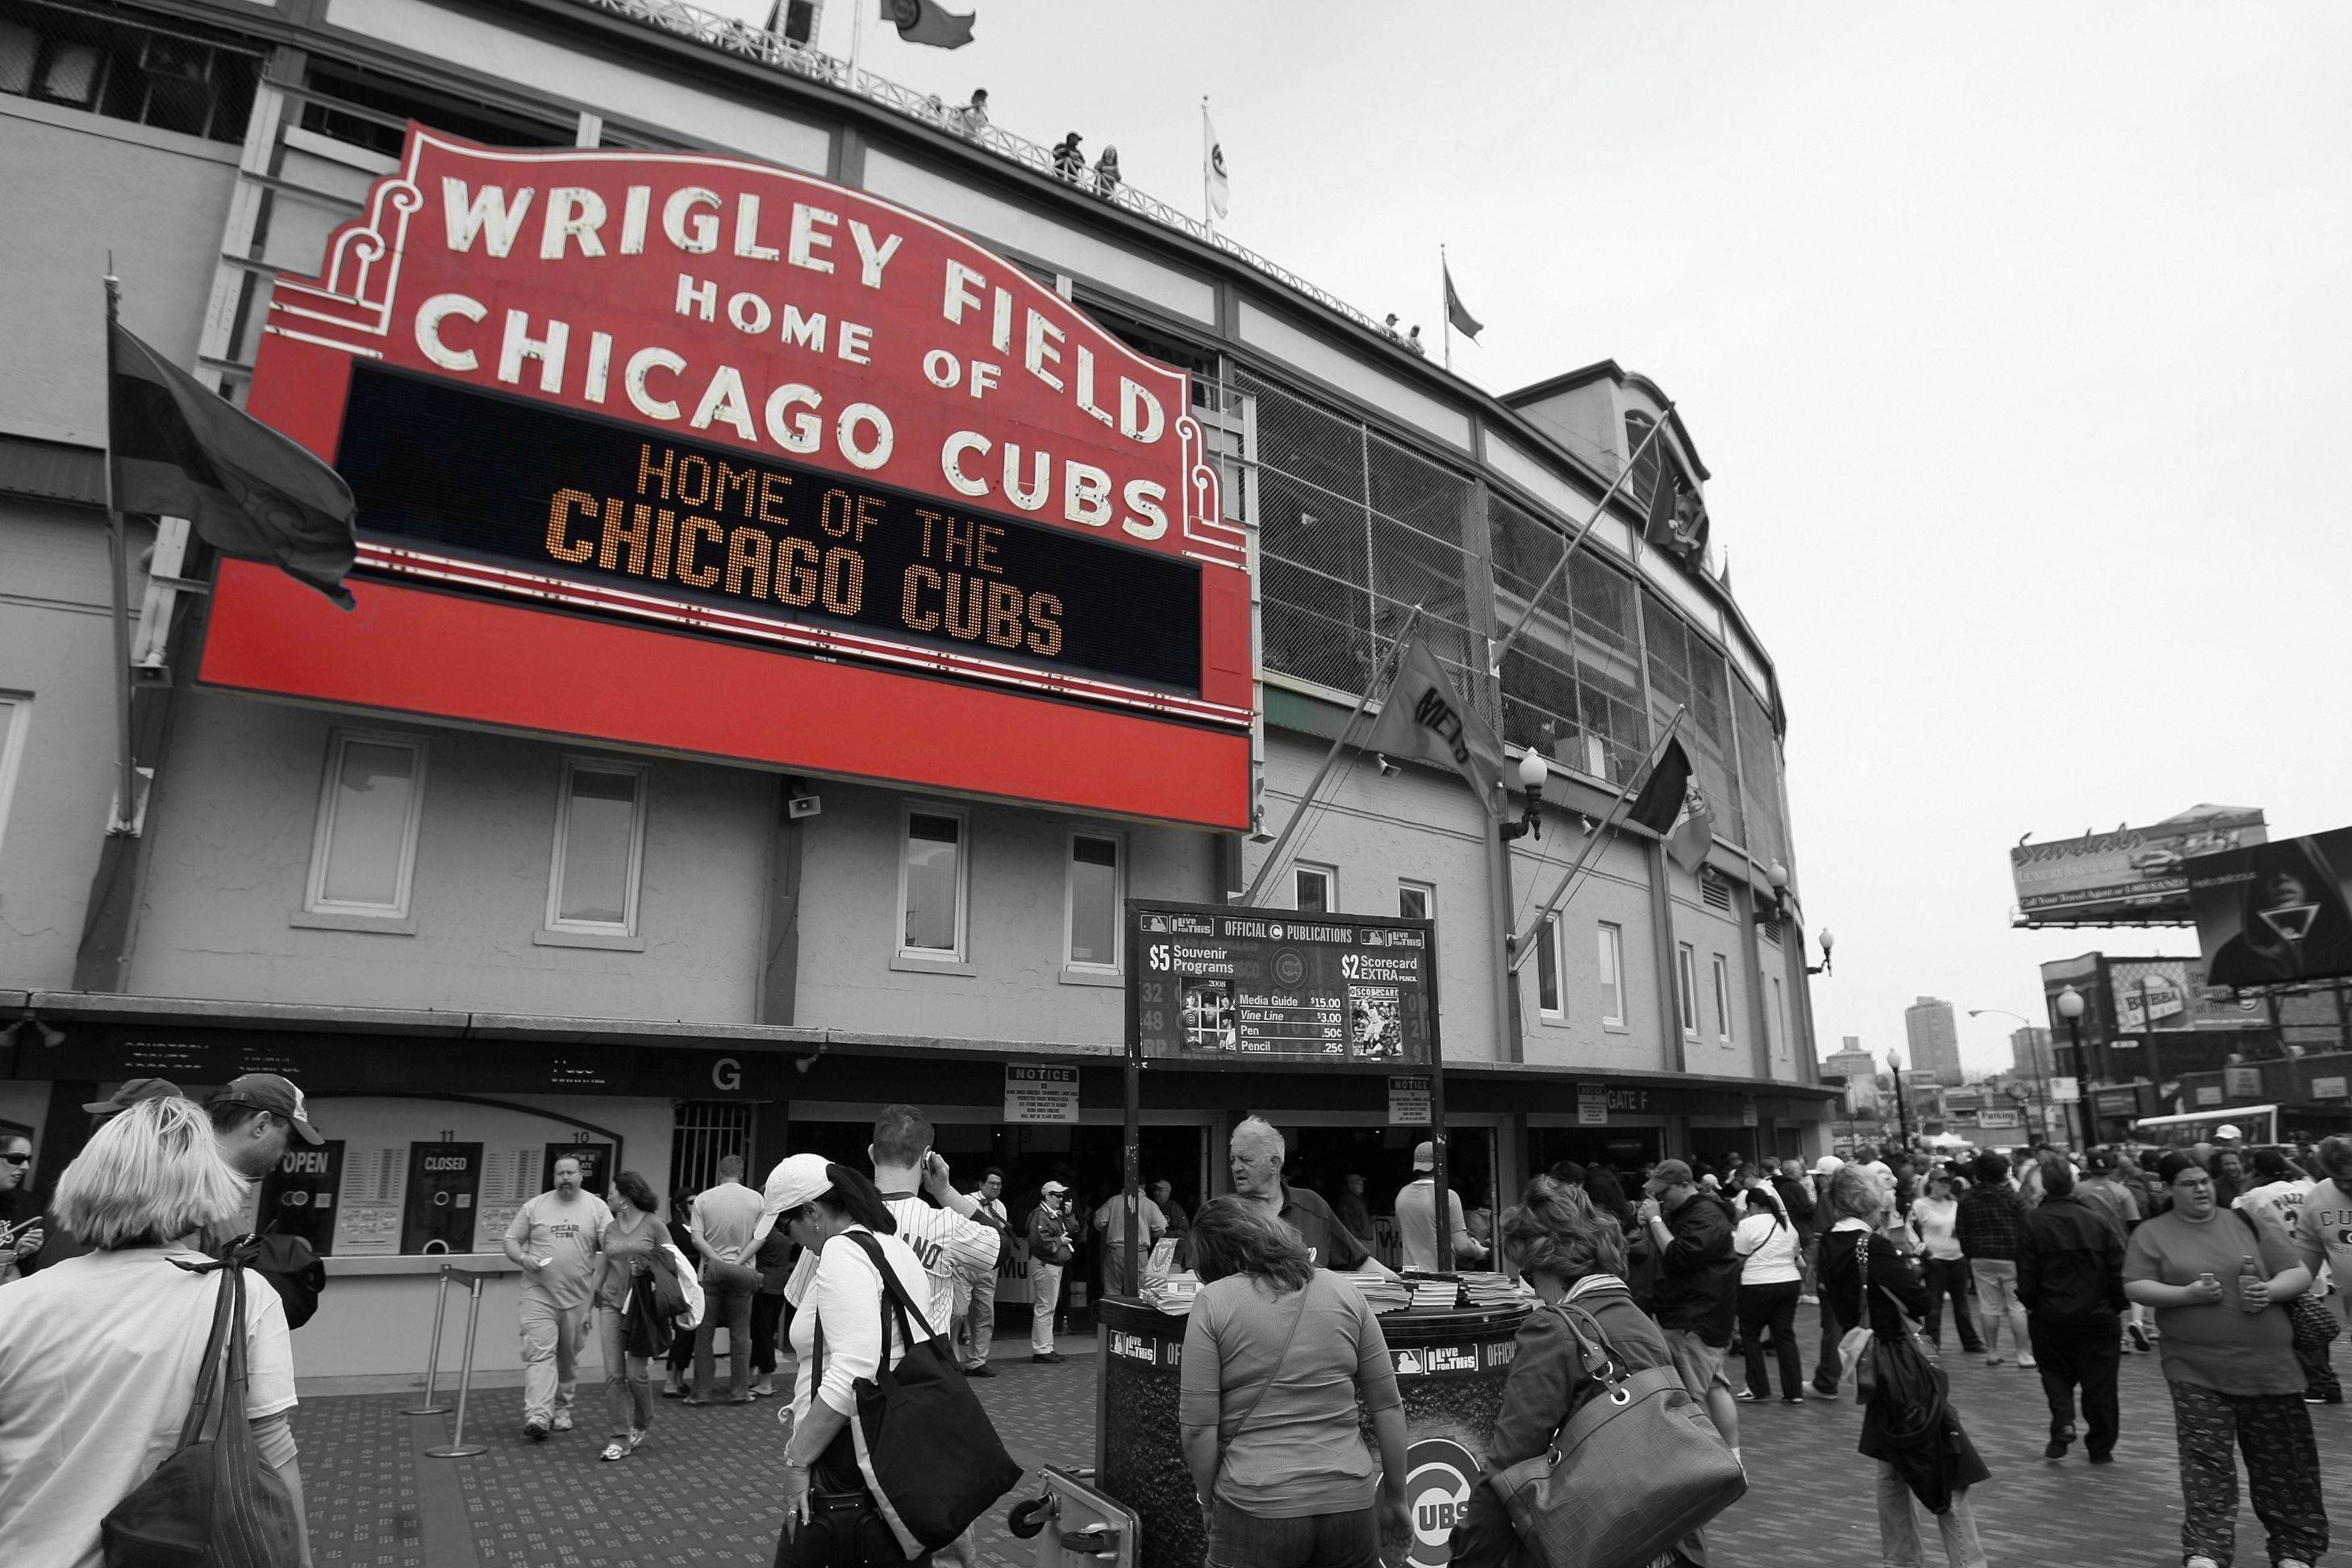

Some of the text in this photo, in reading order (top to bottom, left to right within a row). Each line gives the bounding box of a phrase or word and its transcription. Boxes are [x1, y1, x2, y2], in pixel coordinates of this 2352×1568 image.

[442, 177, 1165, 444] WRIGLEY FIELD
[675, 273, 1001, 398] HOME OF
[414, 293, 1169, 540] CHICAGO CUBS
[637, 444, 1005, 573] HOME OF THE
[545, 487, 1064, 657] CHICAGO CUBS
[2016, 822, 2147, 867] Sandals
[2059, 891, 2087, 902] Travel
[1225, 920, 1267, 938] OFFICIAL
[1287, 924, 1352, 943] PUBLICATIONS
[1149, 944, 1228, 971] $5 Souvenir
[1174, 958, 1234, 974] Programs
[1341, 954, 1417, 979] $2 Scorecard
[1361, 968, 1398, 981] EXTRA
[1208, 979, 1226, 988] 2008
[1240, 995, 1341, 1008] Media Guide $15.00
[1241, 1010, 1342, 1024] Vine Line $3.00
[1241, 1025, 1259, 1036] Pen
[1241, 1040, 1271, 1052] Pencil
[712, 1057, 741, 1091] G
[1016, 1068, 1070, 1081] NOTICE
[1395, 1080, 1428, 1090] NOTICE
[1607, 1089, 1648, 1110] GATE F
[1982, 1110, 2016, 1120] Parking
[440, 1131, 454, 1142] 11
[572, 1131, 590, 1144] 10
[283, 1151, 329, 1173] OPEN
[424, 1157, 467, 1170] CLOSED
[2271, 1193, 2304, 1210] PIAZZ
[2320, 1210, 2352, 1227] CU
[550, 1224, 580, 1232] CHICAGO
[998, 1256, 1028, 1279] Mu
[1167, 1342, 1182, 1366] OF
[1436, 1347, 1458, 1362] Live
